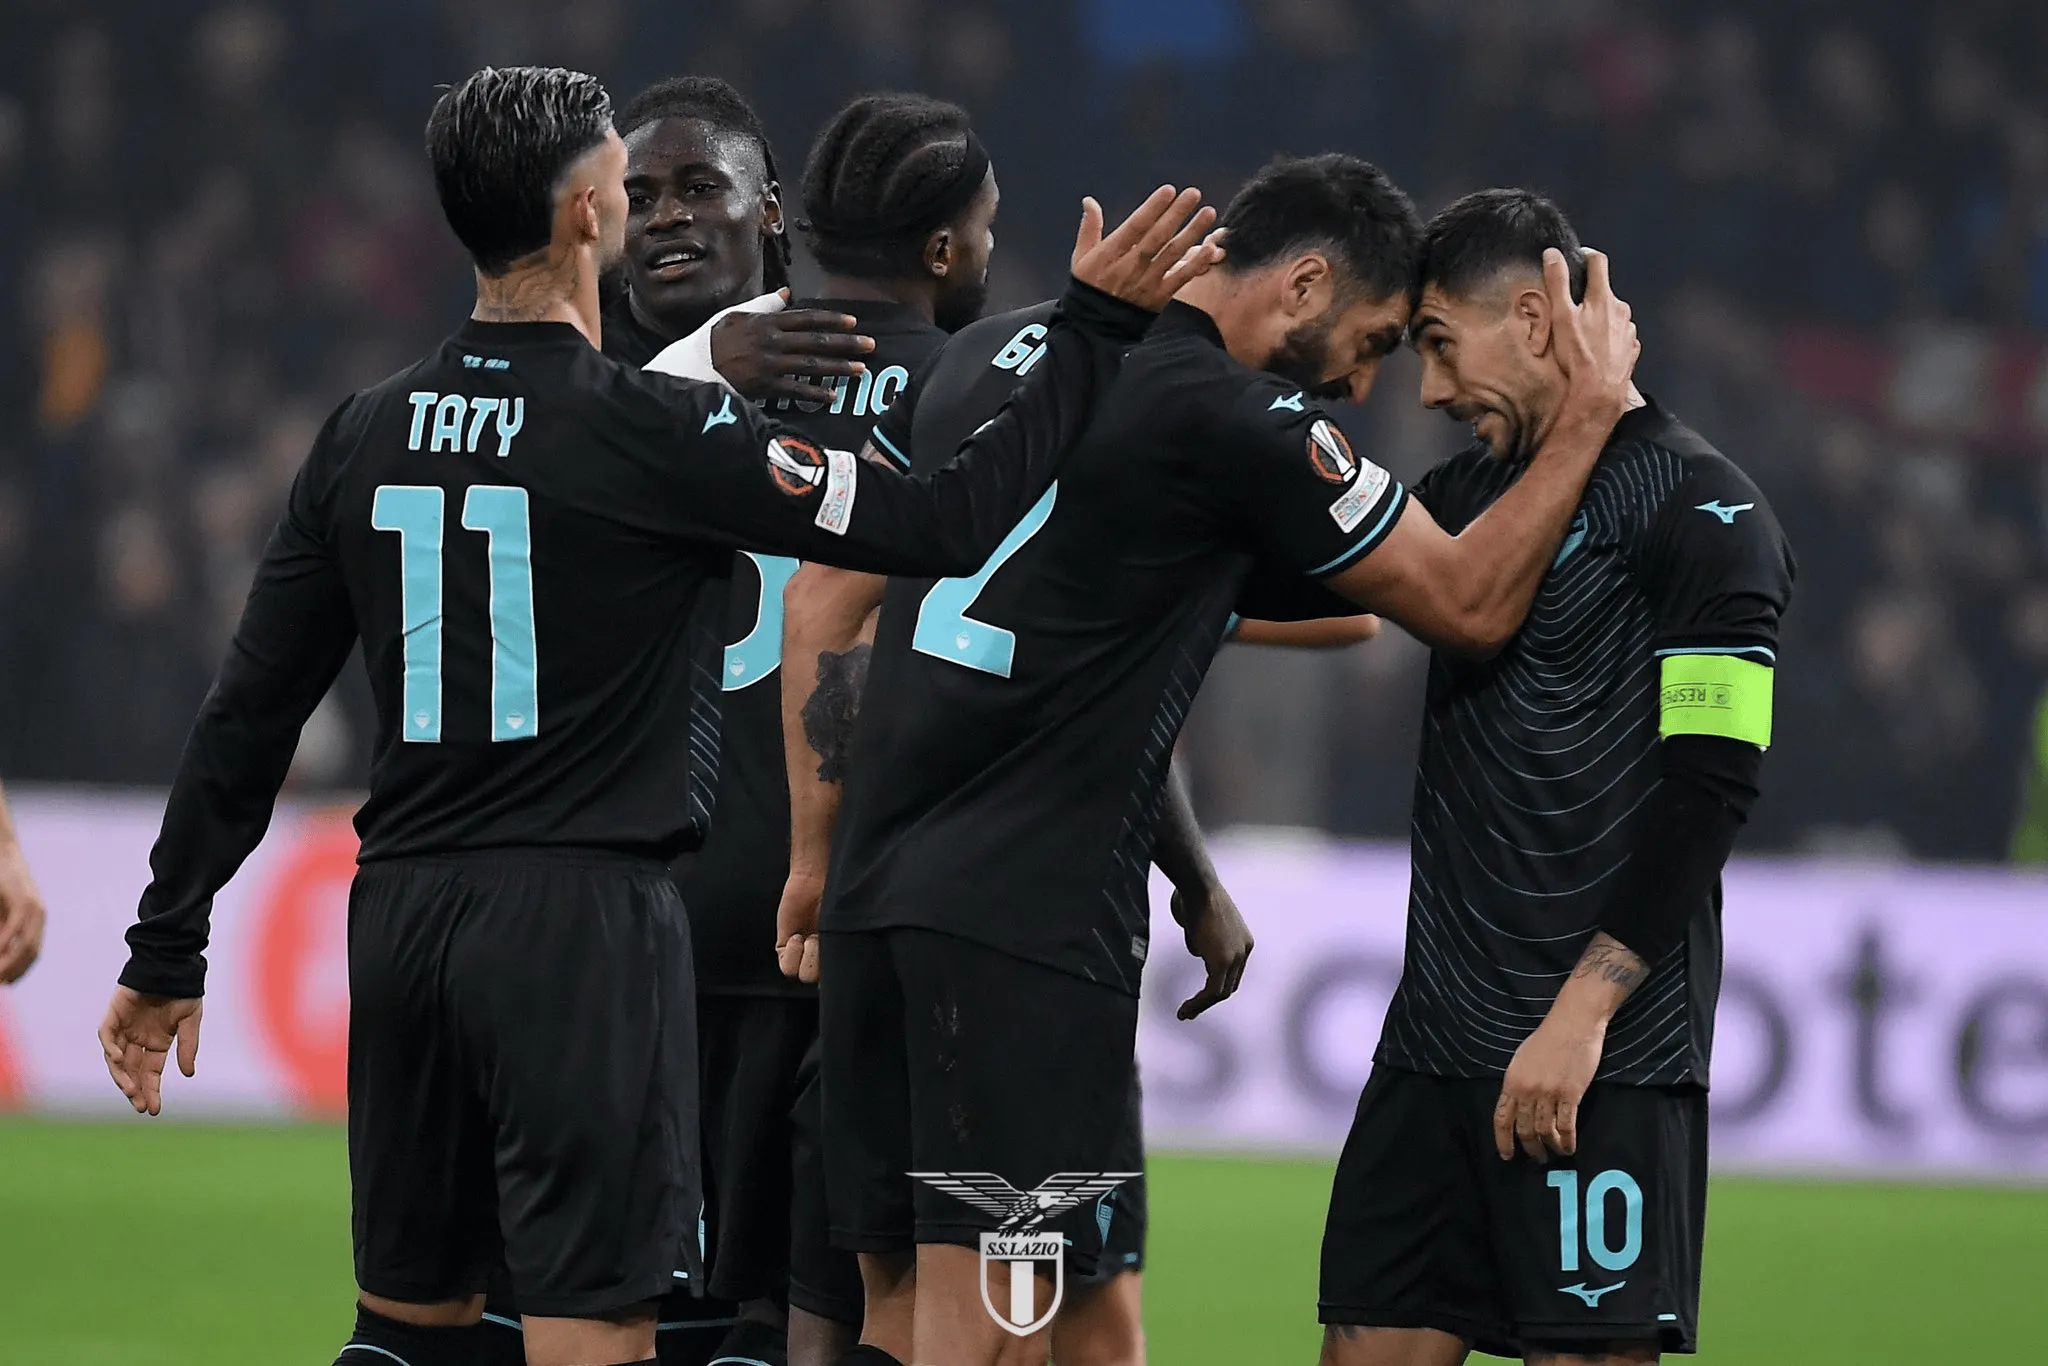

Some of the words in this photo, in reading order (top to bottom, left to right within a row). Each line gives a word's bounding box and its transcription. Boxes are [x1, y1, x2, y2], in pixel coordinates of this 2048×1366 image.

[408, 391, 524, 457] TATY
[371, 484, 538, 743] 11
[1547, 1169, 1643, 1271] 10
